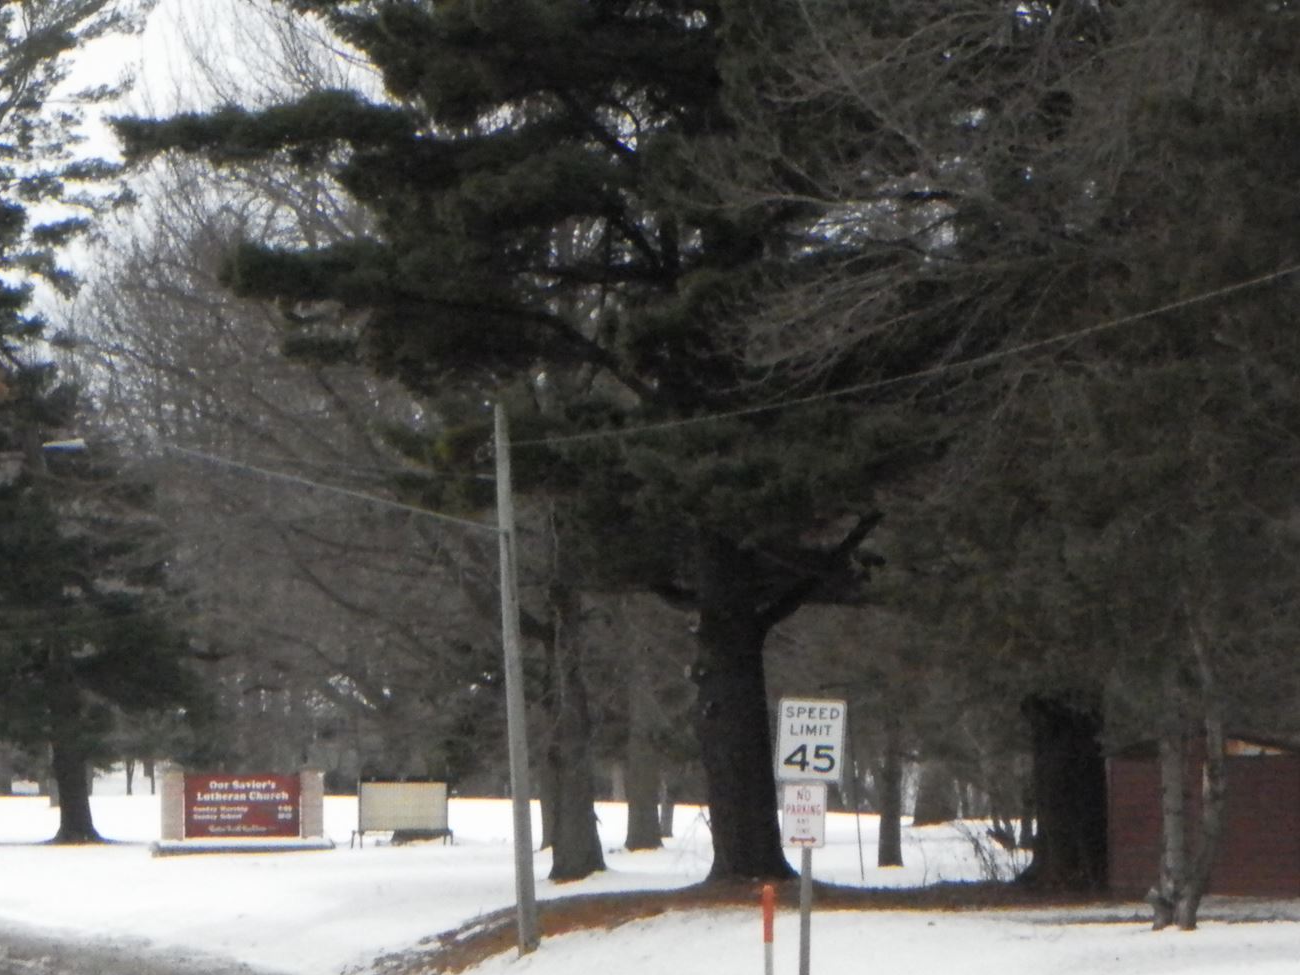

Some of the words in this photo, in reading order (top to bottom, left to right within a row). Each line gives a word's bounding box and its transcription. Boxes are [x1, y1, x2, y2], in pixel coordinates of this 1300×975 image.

[786, 706, 840, 720] SPEED
[790, 723, 832, 736] LIMIT
[783, 743, 836, 773] 45
[209, 780, 228, 789] Our
[232, 780, 276, 789] Savior's
[196, 791, 246, 801] Lutheran
[248, 791, 289, 801] Church
[796, 790, 811, 802] NO
[785, 803, 822, 816] PARKING
